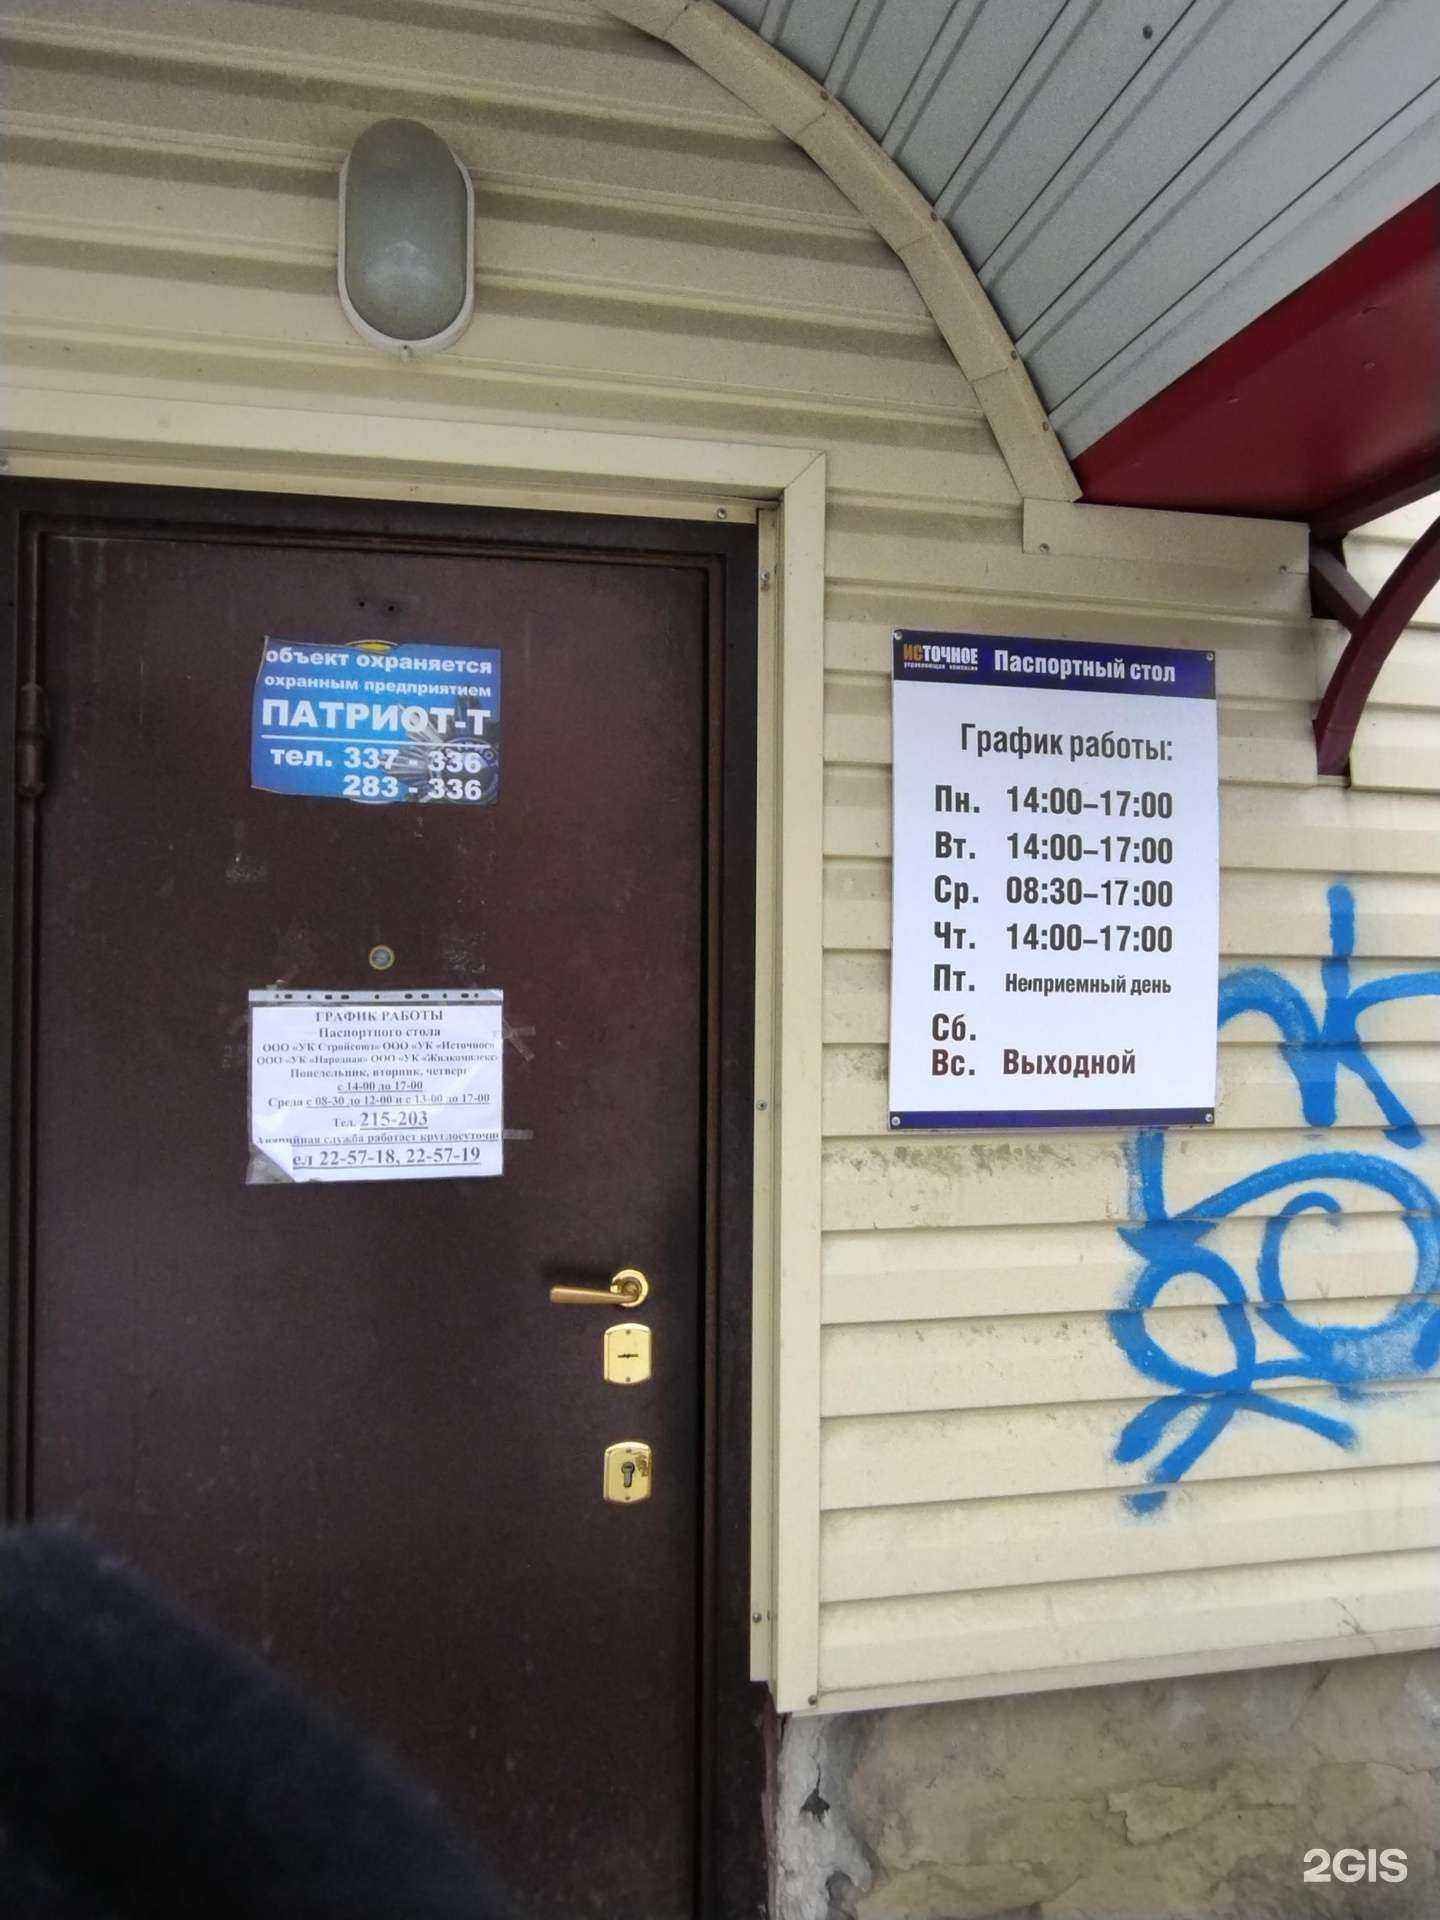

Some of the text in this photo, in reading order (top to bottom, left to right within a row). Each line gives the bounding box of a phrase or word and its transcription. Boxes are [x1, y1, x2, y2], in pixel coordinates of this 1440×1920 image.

[265, 648, 492, 674] объект охраняется
[903, 644, 978, 664] ИСТОЧНОЕ
[994, 650, 1176, 682] Паспортный стол
[264, 674, 491, 697] охранным предприятием
[262, 699, 491, 735] ПАТРИОТ-Т
[961, 724, 1173, 761] График работы:
[271, 749, 333, 767] тел.
[935, 785, 1172, 818] Пн. 14:00–17:00
[935, 831, 1173, 863] Вт. 14:00–17:00
[935, 875, 1173, 909] Ср. 08:30–17:00
[934, 922, 1173, 952] Чт. 14:00–17:00
[933, 964, 1171, 996] Пт. Неприемный день
[316, 1011, 443, 1022] ГРАФИК РАБОТЫ
[932, 1014, 976, 1041] Сб.
[319, 1027, 441, 1039] Паспортного стола
[263, 1043, 289, 1052] ООО
[257, 1056, 282, 1064] ООО
[932, 1049, 1136, 1078] Вс. Выходной
[347, 1081, 375, 1091] 14-00
[396, 1081, 423, 1090] 17-00
[316, 1097, 344, 1105] 08-30
[365, 1096, 392, 1105] 12-00
[463, 1094, 490, 1102] 17-00
[360, 1111, 428, 1127] 215-203
[320, 1149, 400, 1167] 22-57-18,
[407, 1147, 480, 1163] 22-57-19
